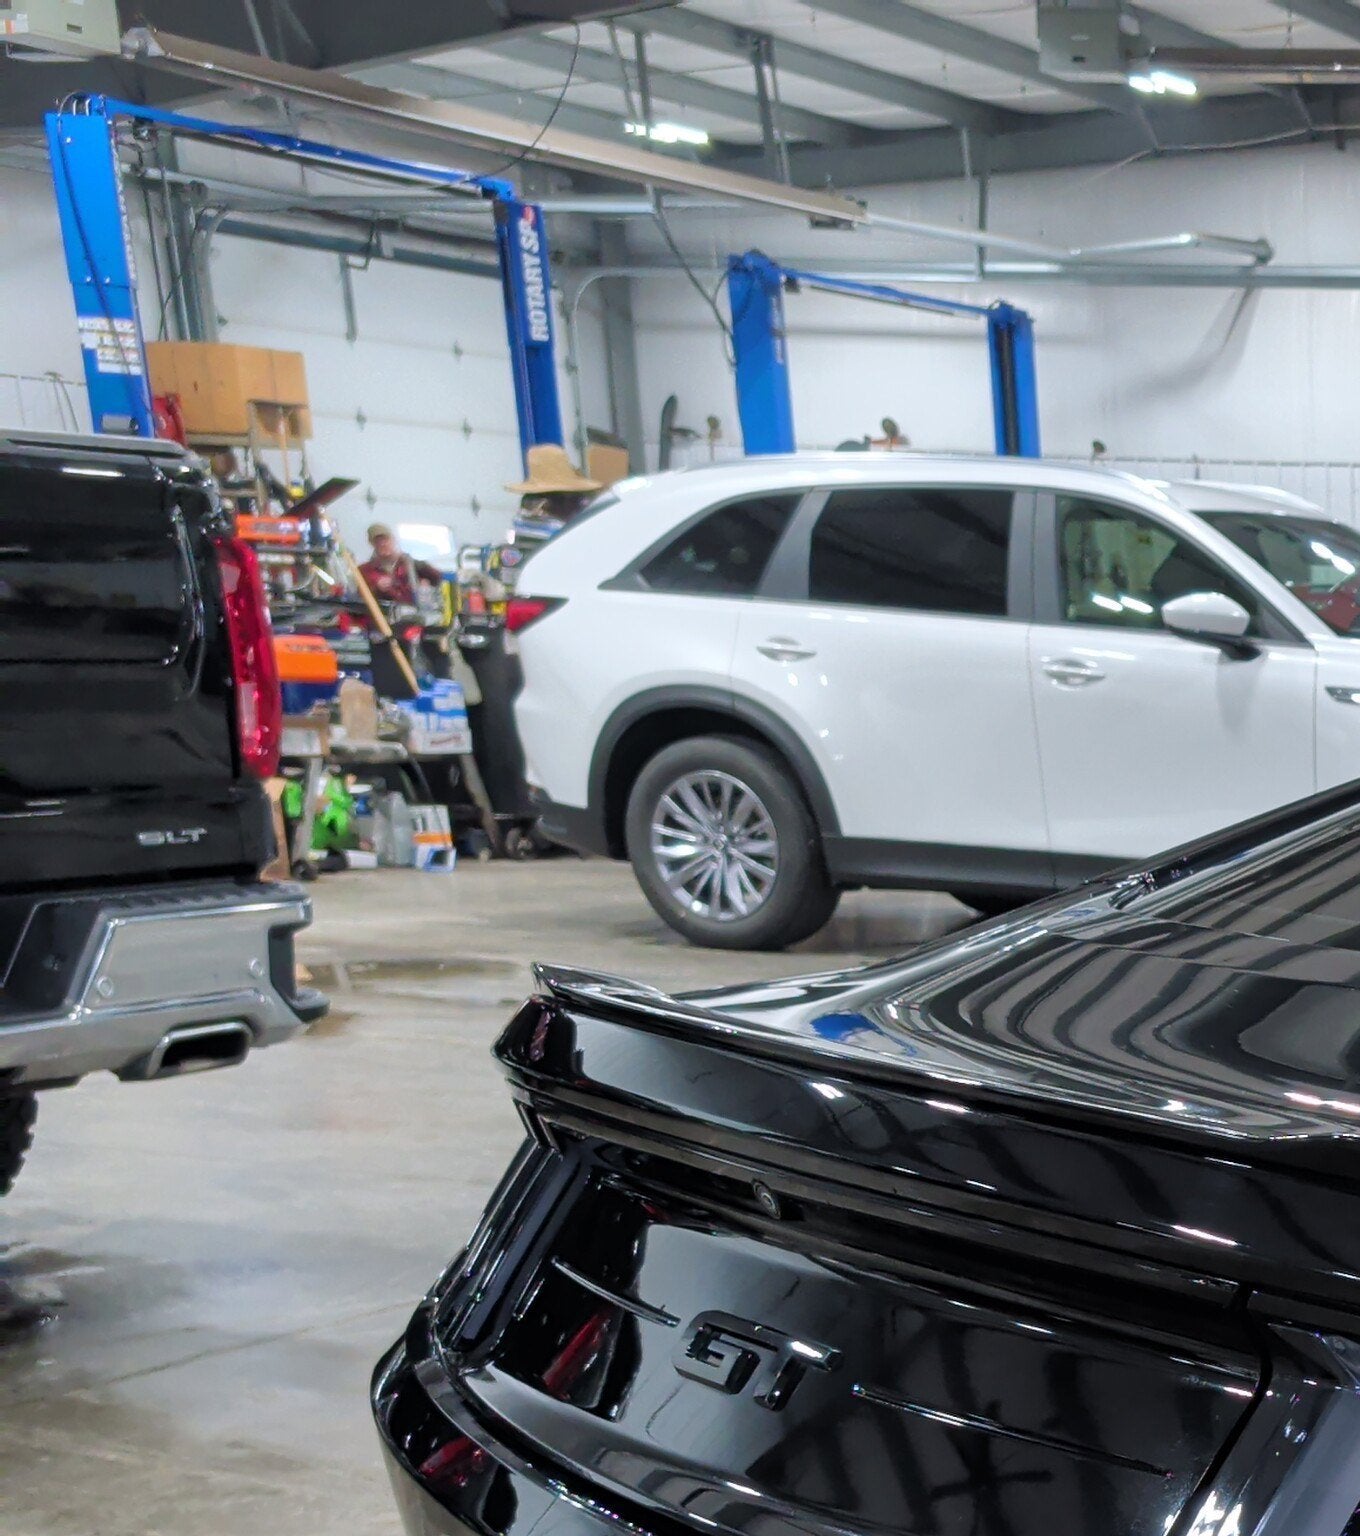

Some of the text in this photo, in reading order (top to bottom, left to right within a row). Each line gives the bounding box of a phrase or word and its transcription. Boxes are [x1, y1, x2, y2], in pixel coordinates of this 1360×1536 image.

[521, 253, 549, 342] ROTARY
[137, 827, 208, 847] SLT
[673, 1310, 844, 1412] GT
